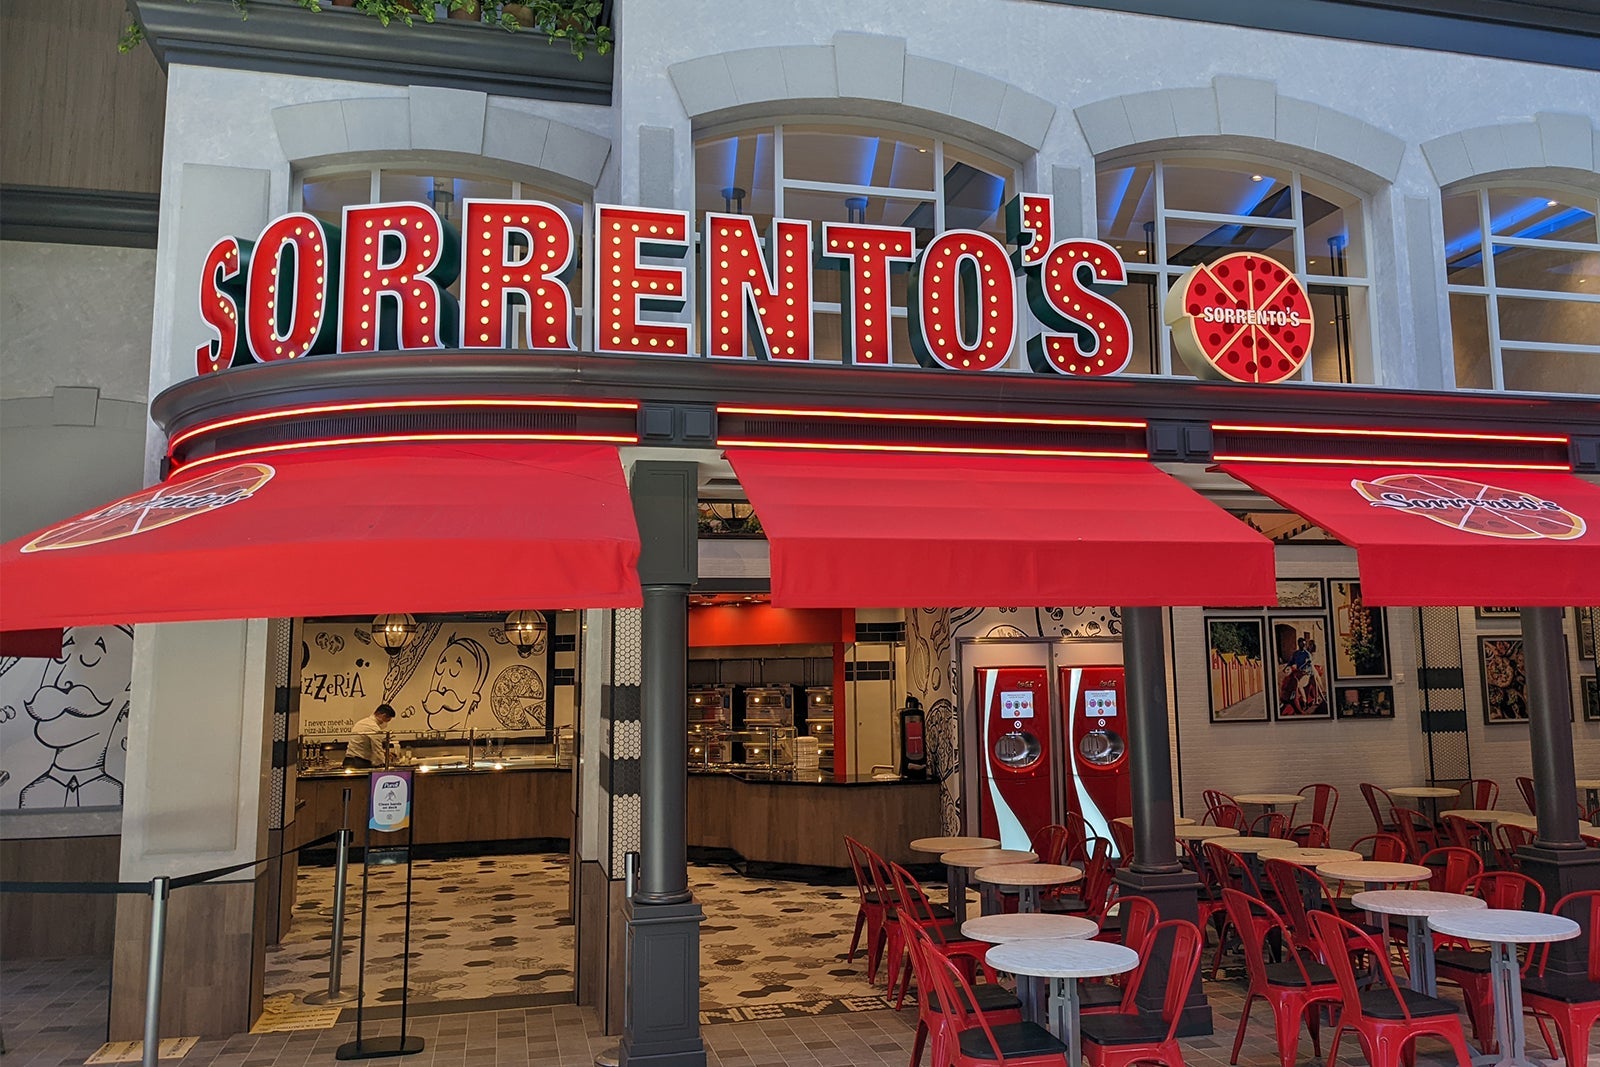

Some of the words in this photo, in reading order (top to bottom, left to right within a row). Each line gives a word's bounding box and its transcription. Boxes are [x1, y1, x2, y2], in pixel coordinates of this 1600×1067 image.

[195, 193, 1135, 379] SORRENTO'S
[1202, 306, 1301, 327] SORRENTO'S
[1371, 491, 1563, 512] Sorrento's
